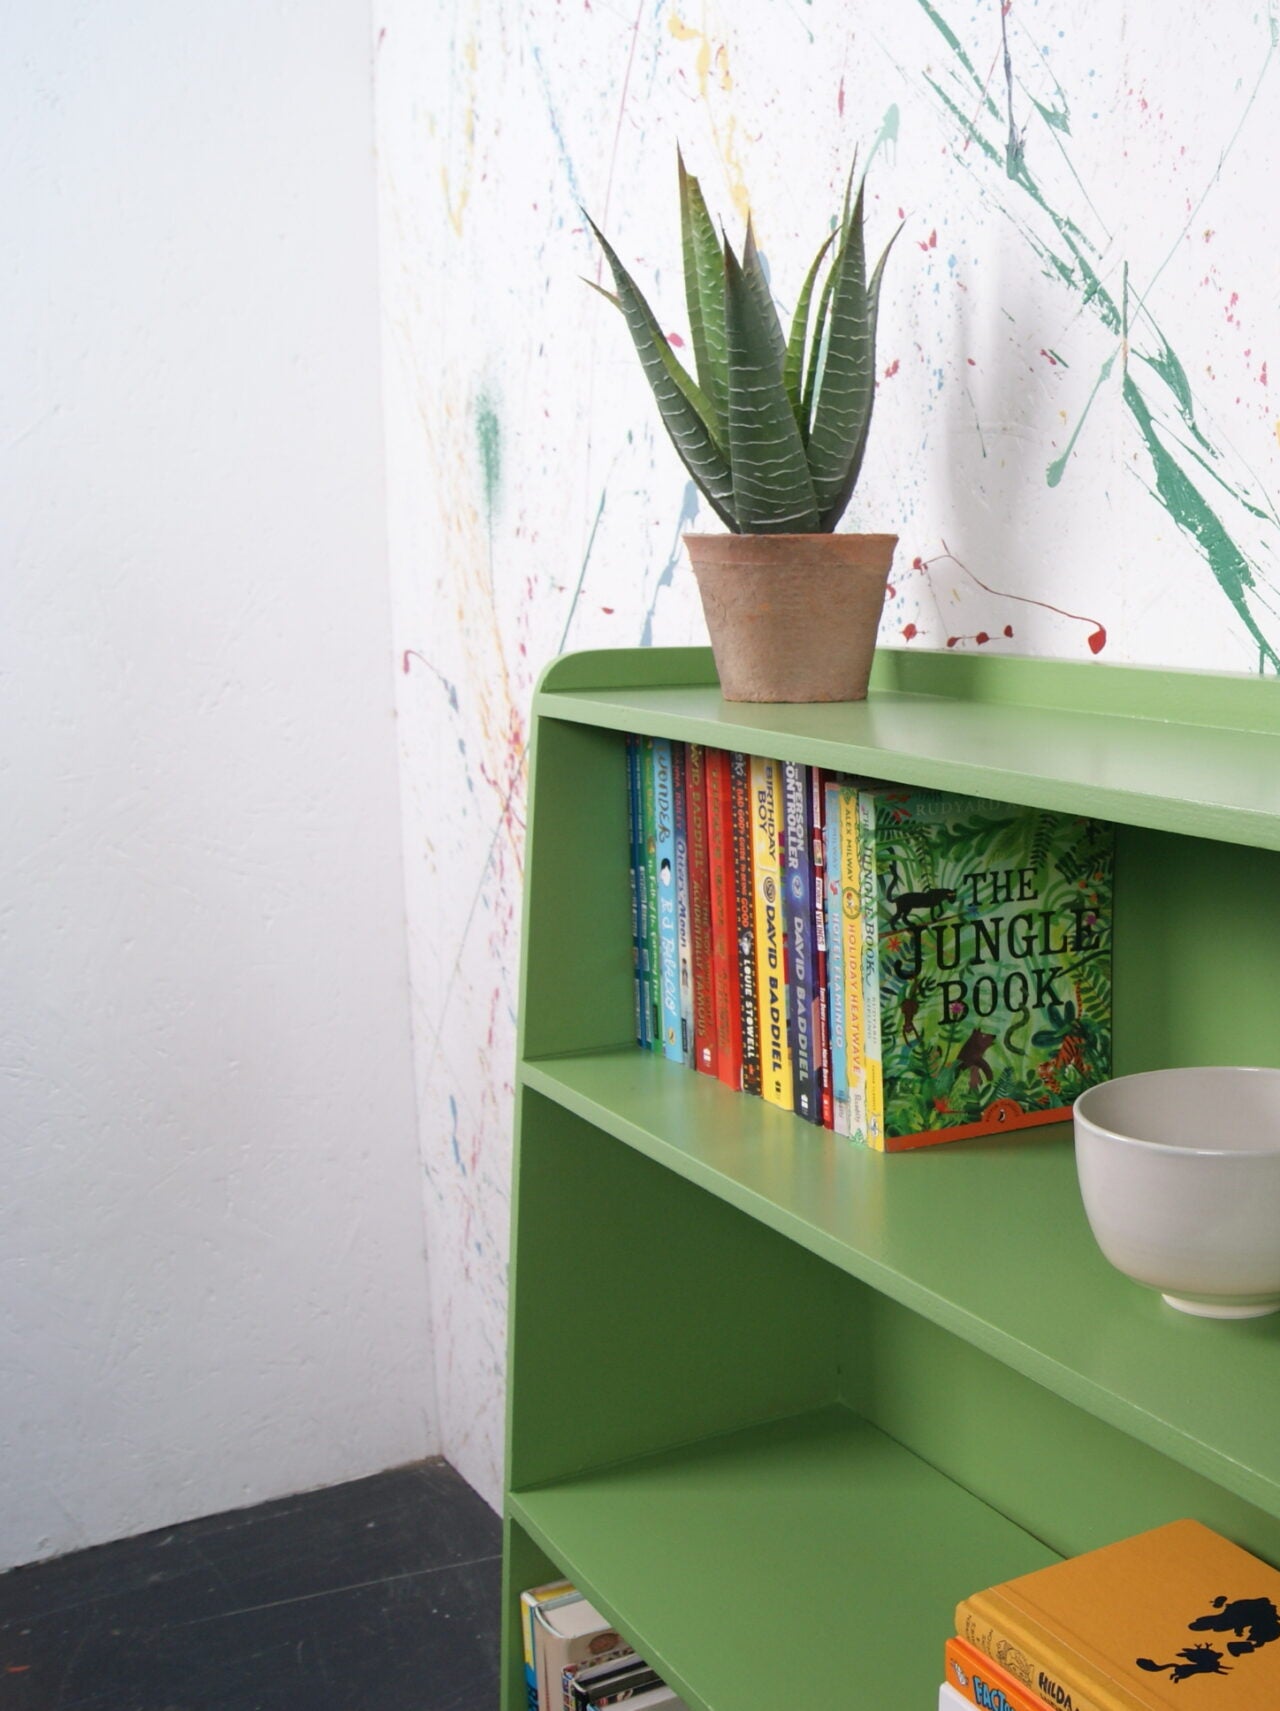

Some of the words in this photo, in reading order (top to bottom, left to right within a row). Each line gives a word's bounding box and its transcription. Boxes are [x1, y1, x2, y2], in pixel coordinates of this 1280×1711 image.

[690, 742, 702, 787] AVID
[692, 792, 704, 868] BADDIEL
[757, 790, 769, 834] BOY
[765, 766, 777, 862] BIRTHDAY
[794, 781, 805, 852] PERSON
[845, 808, 853, 835] ALEX
[736, 788, 745, 808] BAD
[741, 896, 750, 928] GOOD
[846, 840, 855, 883] MILWAY
[963, 866, 1039, 906] THE
[766, 905, 779, 970] DAVID
[793, 916, 805, 981] DAVID
[831, 912, 841, 960] HOTEL
[847, 923, 858, 988] HOLIDAY
[864, 922, 876, 984] BOOK
[894, 907, 1101, 980] JUNGLE
[695, 974, 708, 1037] FAMOUS
[742, 959, 753, 996] LOUIE
[833, 965, 844, 1049] FLAMINGO
[936, 966, 1066, 1026] BOOK
[744, 1001, 756, 1058] STOWELL
[768, 976, 783, 1073] BADDIEL
[795, 985, 808, 1082] BADDIEL
[849, 995, 862, 1074] HEATWAVE
[1038, 1672, 1073, 1711] HILDA
